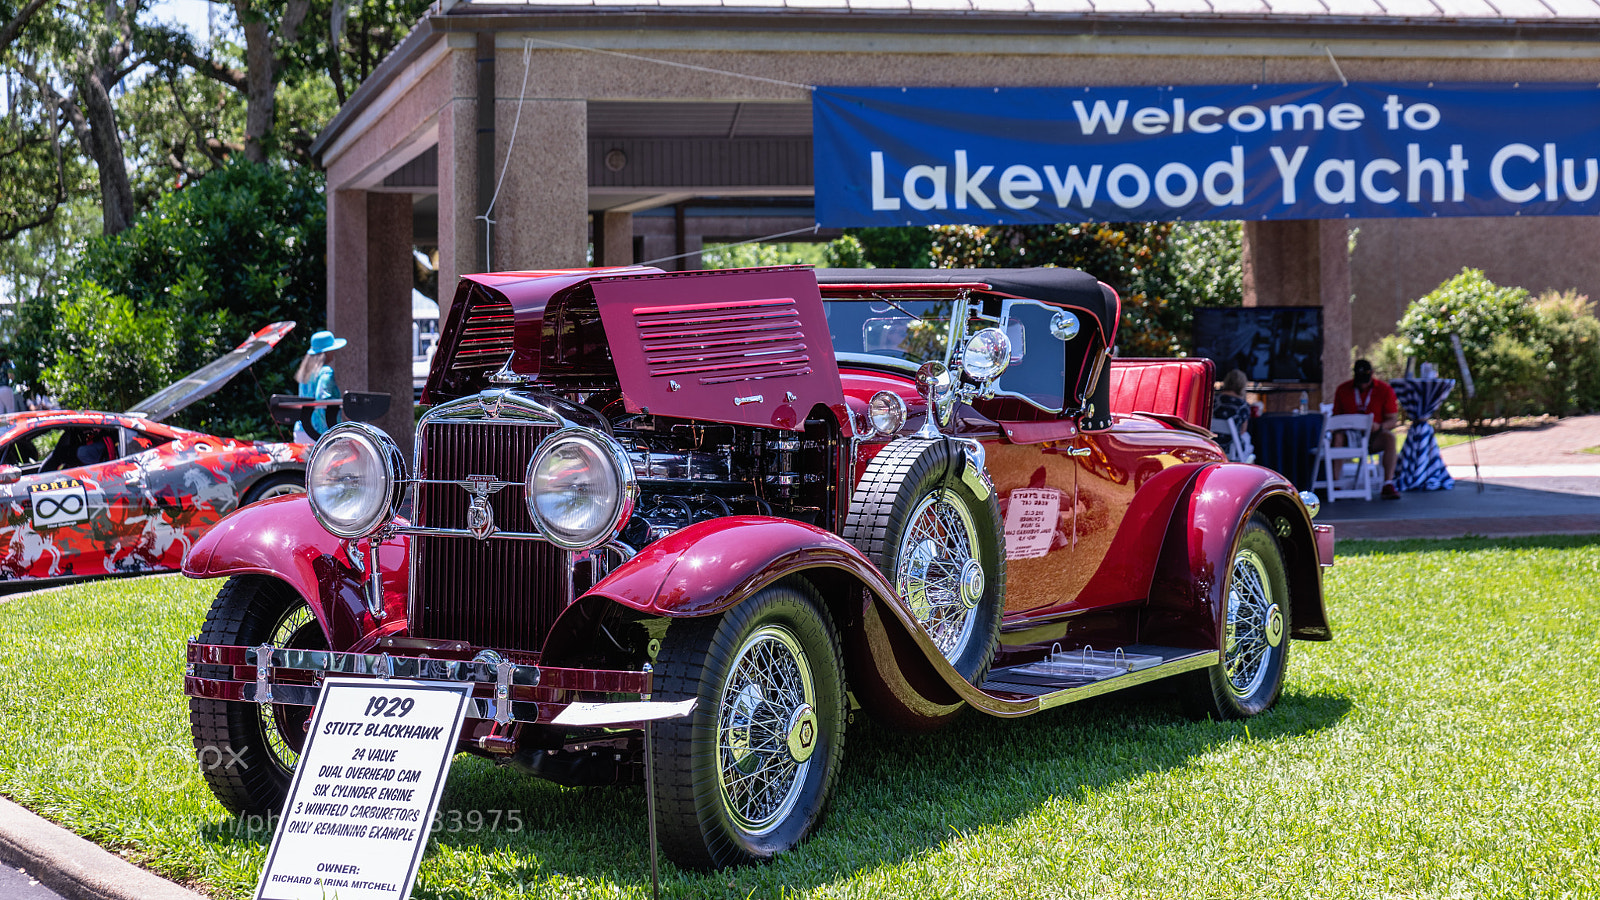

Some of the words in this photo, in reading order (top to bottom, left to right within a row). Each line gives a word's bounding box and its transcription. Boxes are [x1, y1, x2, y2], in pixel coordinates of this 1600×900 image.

[1072, 99, 1365, 135] Welcome
[1383, 94, 1441, 131] to
[870, 145, 1246, 211] Lakewood
[1269, 143, 1469, 204] Yacht
[1489, 142, 1600, 203] Clu
[31, 479, 80, 493] FORZA
[364, 695, 415, 718] 1929
[323, 721, 364, 737] STUTZ
[364, 723, 444, 741] BLACKHAWK
[351, 747, 366, 761] 24
[367, 748, 399, 763] VALVE
[318, 764, 343, 779] DUAL
[345, 766, 396, 782] OVERHEAD
[396, 768, 422, 783] CAM
[312, 783, 329, 797] SIX
[330, 784, 377, 800] CYLINDER
[377, 787, 415, 802] ENGINE
[294, 801, 303, 815] 3
[304, 802, 349, 817] WINFIELD
[349, 804, 421, 822] CARBURETORS
[288, 820, 314, 834] ONLY
[313, 822, 367, 838] REMAINING
[368, 825, 416, 842] EXAMPLE
[316, 862, 360, 875] OWNER:
[271, 874, 312, 885] RICHARD
[313, 877, 322, 885] &
[323, 878, 349, 888] IRINA
[350, 881, 397, 892] MITCHELL
